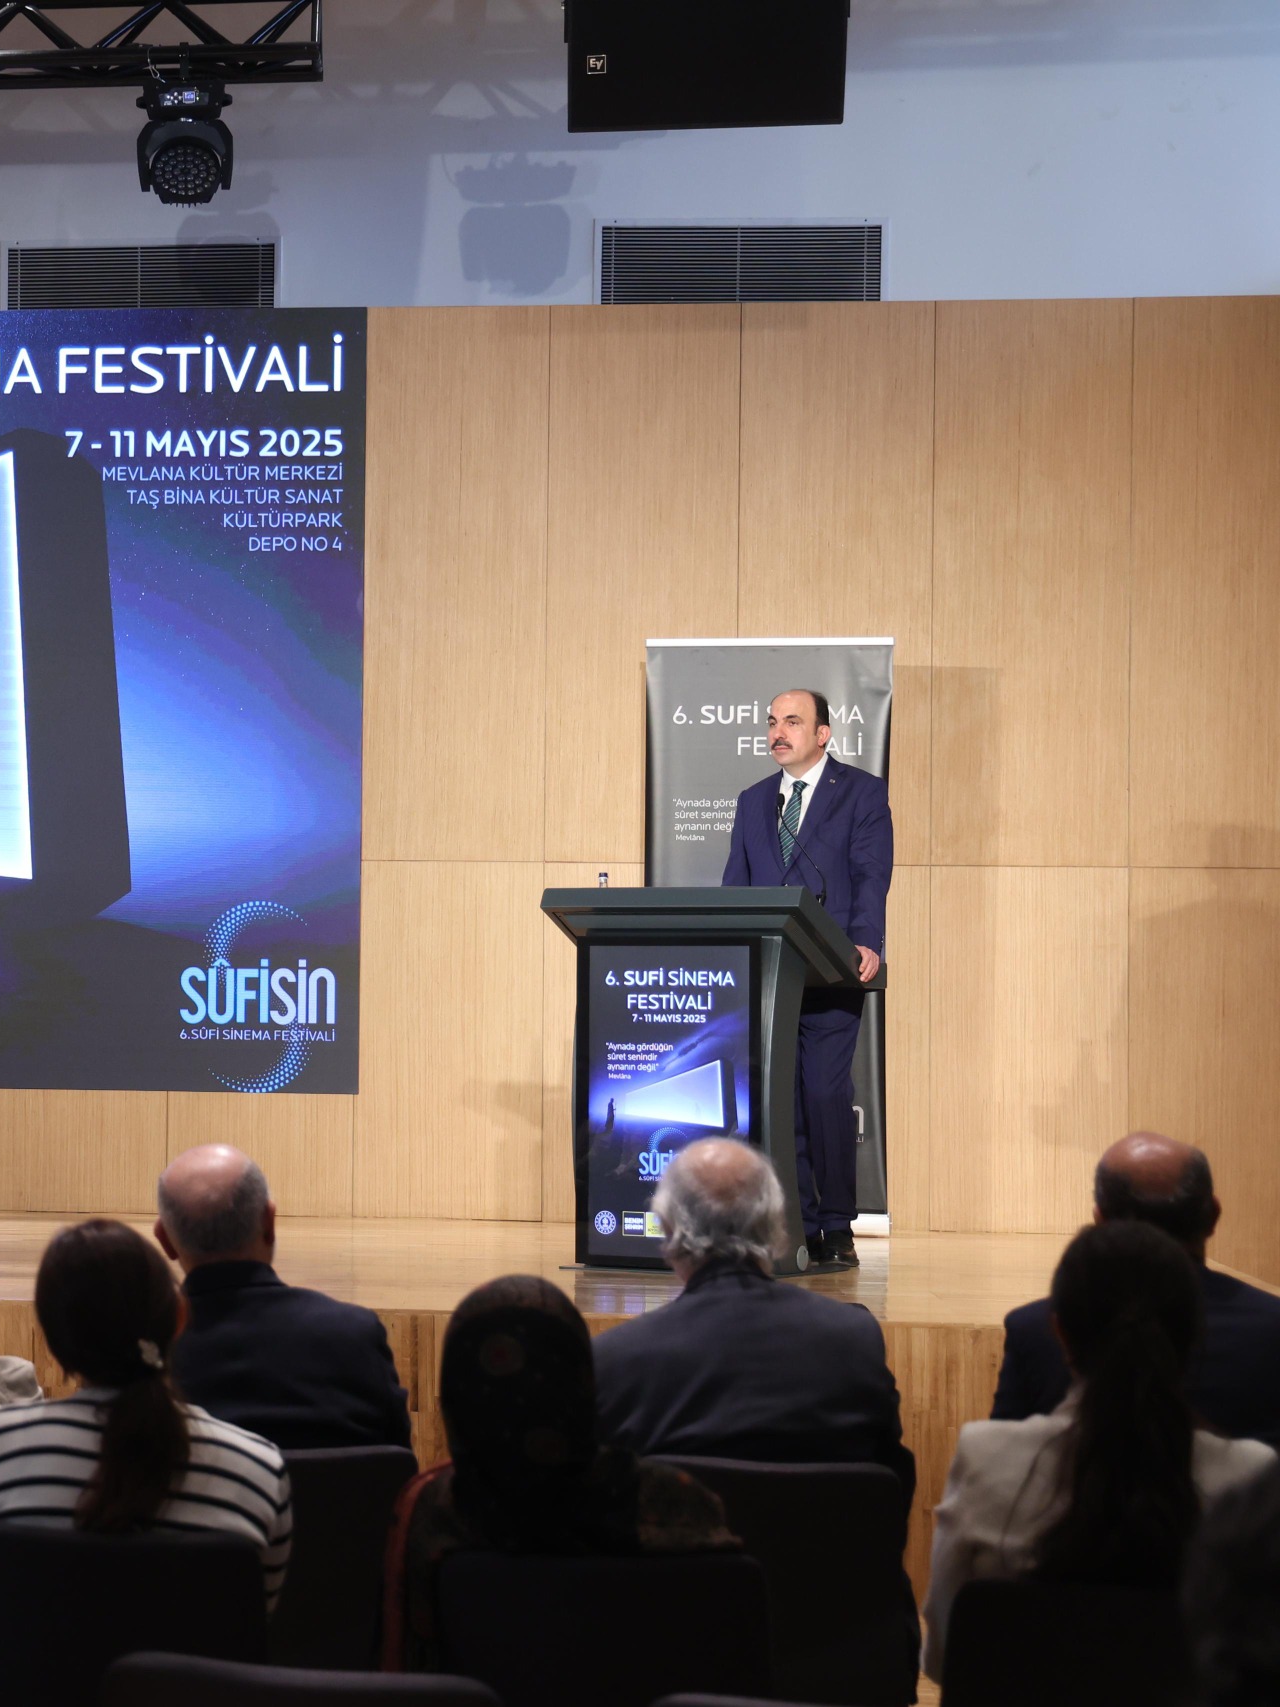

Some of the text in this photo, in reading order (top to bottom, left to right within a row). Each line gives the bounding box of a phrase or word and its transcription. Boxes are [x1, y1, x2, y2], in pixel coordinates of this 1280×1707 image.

[58, 334, 343, 394] FESTİVALİ
[65, 430, 83, 457] 7
[110, 430, 136, 457] 11
[146, 430, 250, 457] MAYIS
[259, 429, 343, 457] 2025
[102, 462, 343, 481] MEVLANA KÜLTÜR MERKEZİ
[127, 487, 344, 509] TAŞ BİNA KÜLTÜR SANAT
[223, 510, 343, 528] KÜLTÜRPARK
[249, 536, 342, 552] DEPO NO 4
[672, 705, 693, 725] 6.
[700, 701, 759, 724] SUFİ
[674, 810, 736, 819] sûret senindi
[674, 823, 711, 832] aynanın
[605, 967, 735, 987] 6. SUFİ SİNEMA
[627, 991, 712, 1010] FESTİVALİ
[632, 1014, 638, 1022] 7
[644, 1014, 652, 1022] 11
[653, 1014, 682, 1023] MAYIS
[683, 1014, 707, 1023] 2025
[222, 1028, 271, 1041] SİNEMA
[274, 1029, 335, 1042] FESTİVALİ
[636, 1042, 674, 1052] gördüğün
[607, 1053, 658, 1061] sûret senindir
[607, 1063, 636, 1071] aynanın
